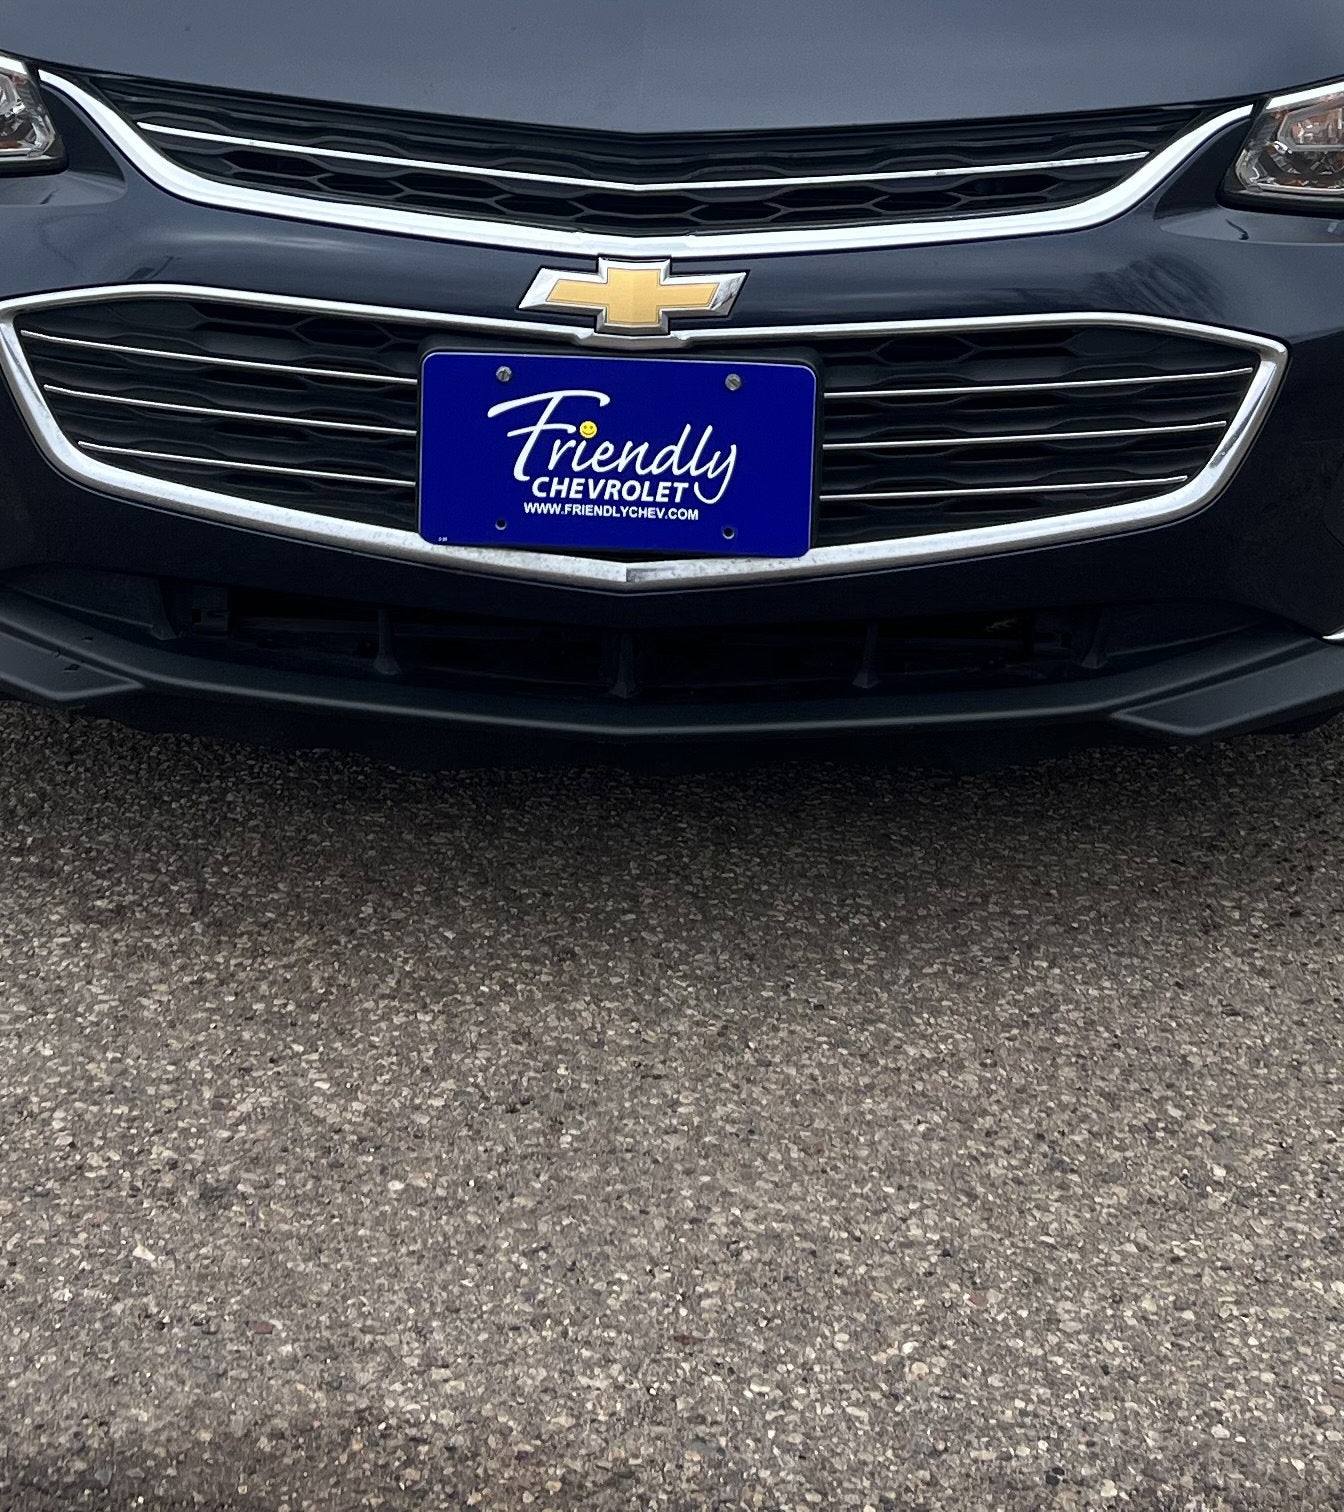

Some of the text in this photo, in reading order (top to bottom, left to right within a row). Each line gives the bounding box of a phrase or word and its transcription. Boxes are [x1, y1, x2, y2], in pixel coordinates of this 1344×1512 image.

[487, 390, 737, 504] Friendly
[532, 476, 689, 503] CHEVROLET
[523, 501, 699, 521] WWW.FRIENDLYCHEV.COM
